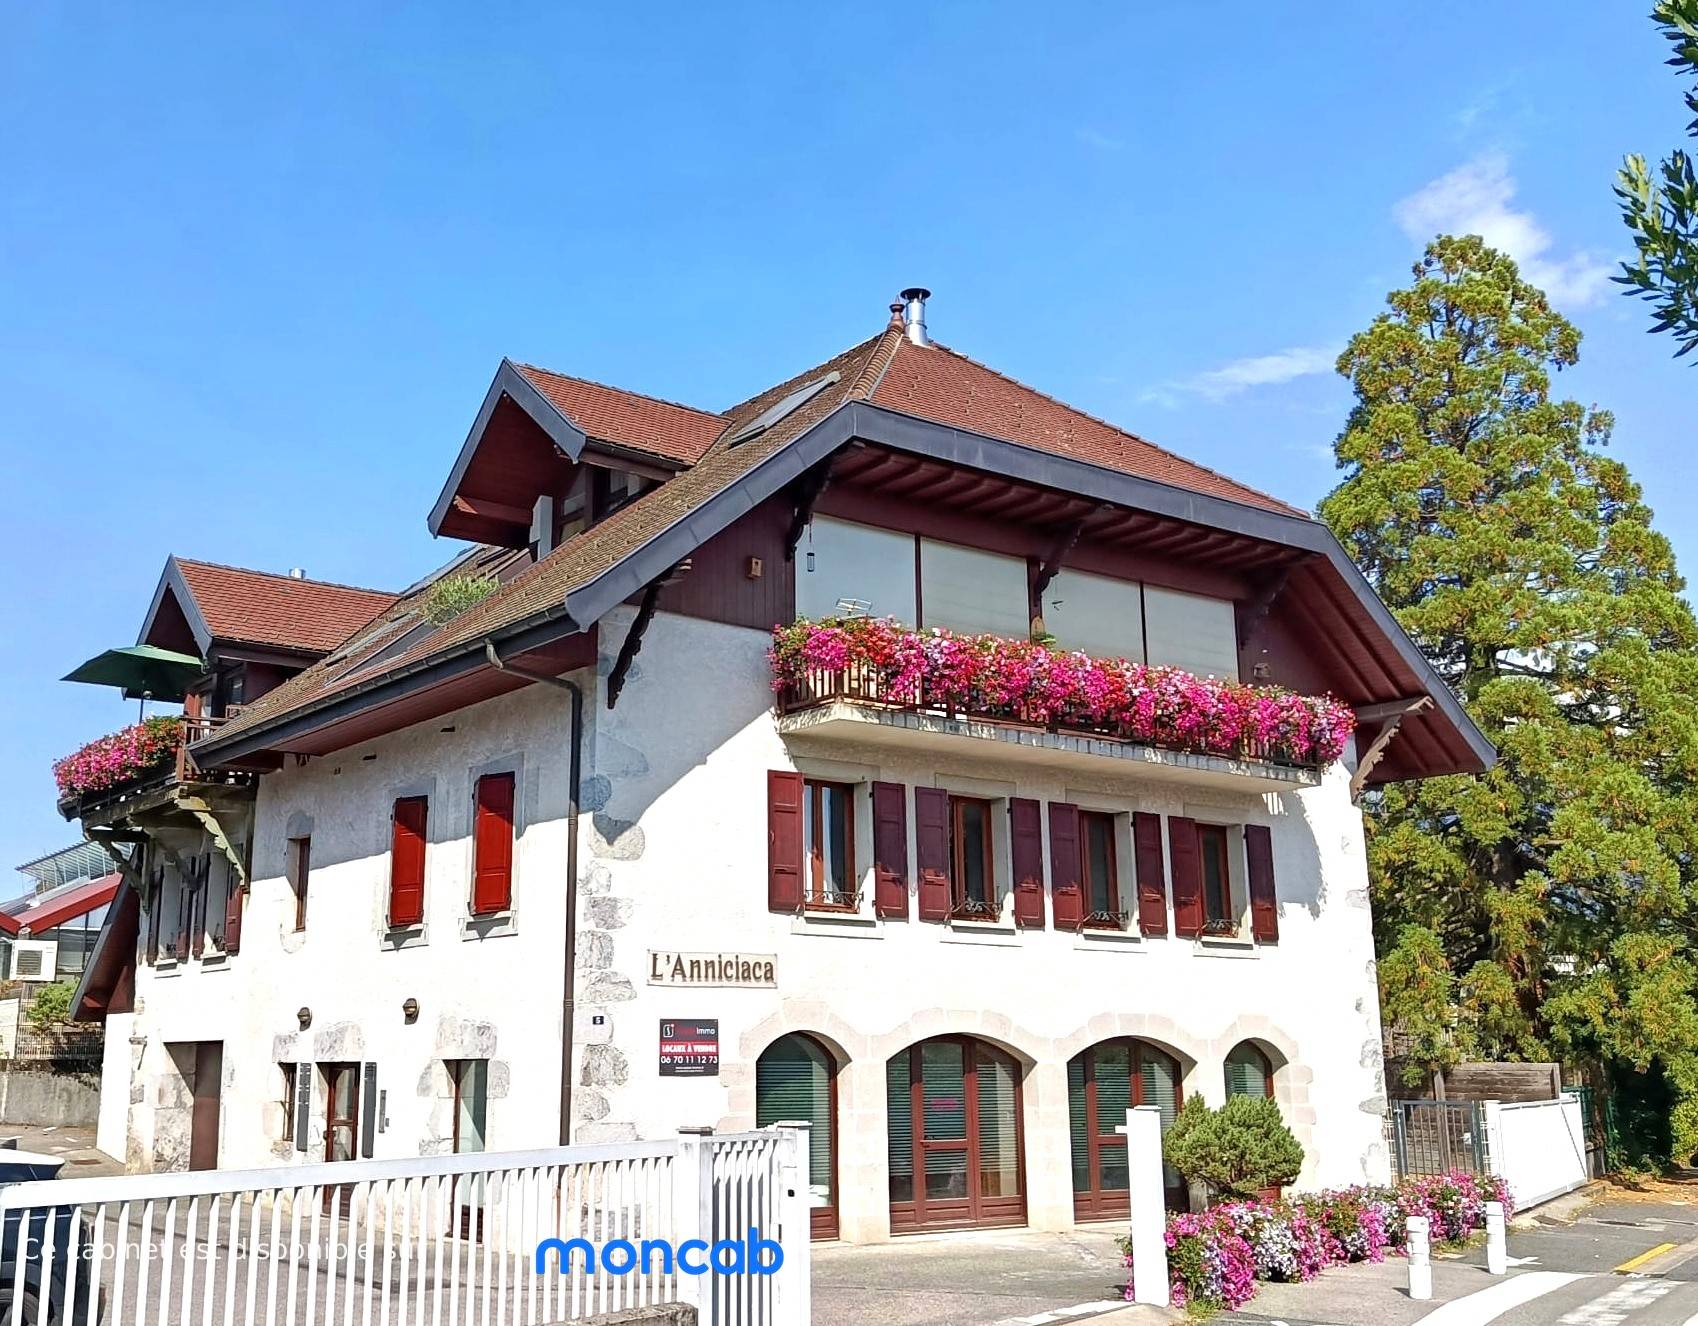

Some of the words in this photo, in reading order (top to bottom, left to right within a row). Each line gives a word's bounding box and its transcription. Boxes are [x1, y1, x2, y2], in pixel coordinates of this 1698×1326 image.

[651, 953, 774, 982] L'Anniciaca
[660, 1055, 672, 1064] 06
[673, 1055, 684, 1064] 70
[685, 1055, 694, 1064] 11
[697, 1055, 707, 1064] 12
[708, 1055, 718, 1064] 73
